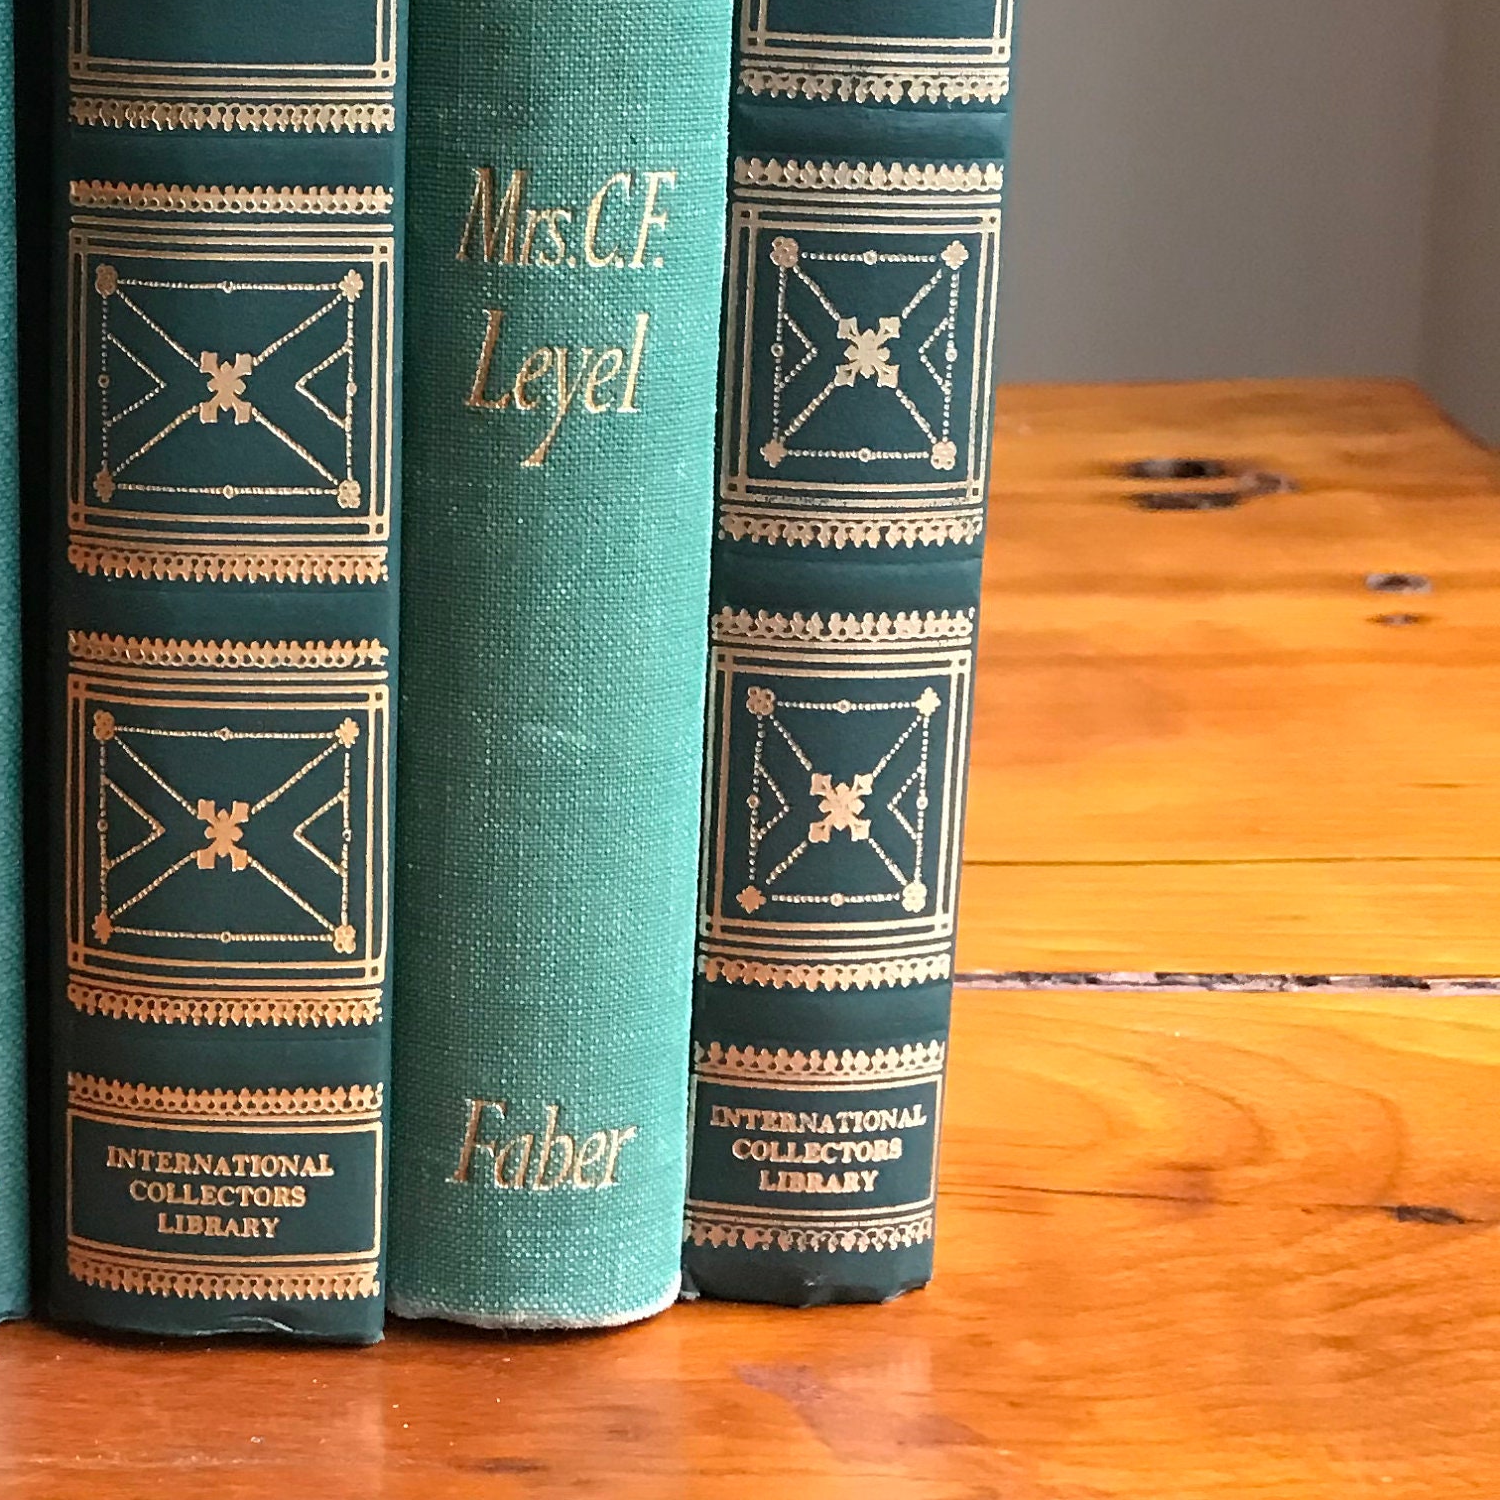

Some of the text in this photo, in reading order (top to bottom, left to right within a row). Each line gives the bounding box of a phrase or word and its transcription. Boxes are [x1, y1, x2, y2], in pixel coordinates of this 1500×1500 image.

[464, 308, 651, 468] Leyel
[709, 1103, 928, 1135] INTERNATIONAL
[444, 1098, 640, 1191] Faber
[731, 1137, 904, 1165] COLLECTORS
[105, 1145, 335, 1178] INTERNATIONAL
[129, 1179, 308, 1208] COLLECTORS
[758, 1169, 880, 1194] LIBRARY
[157, 1212, 281, 1239] LIBRARY
